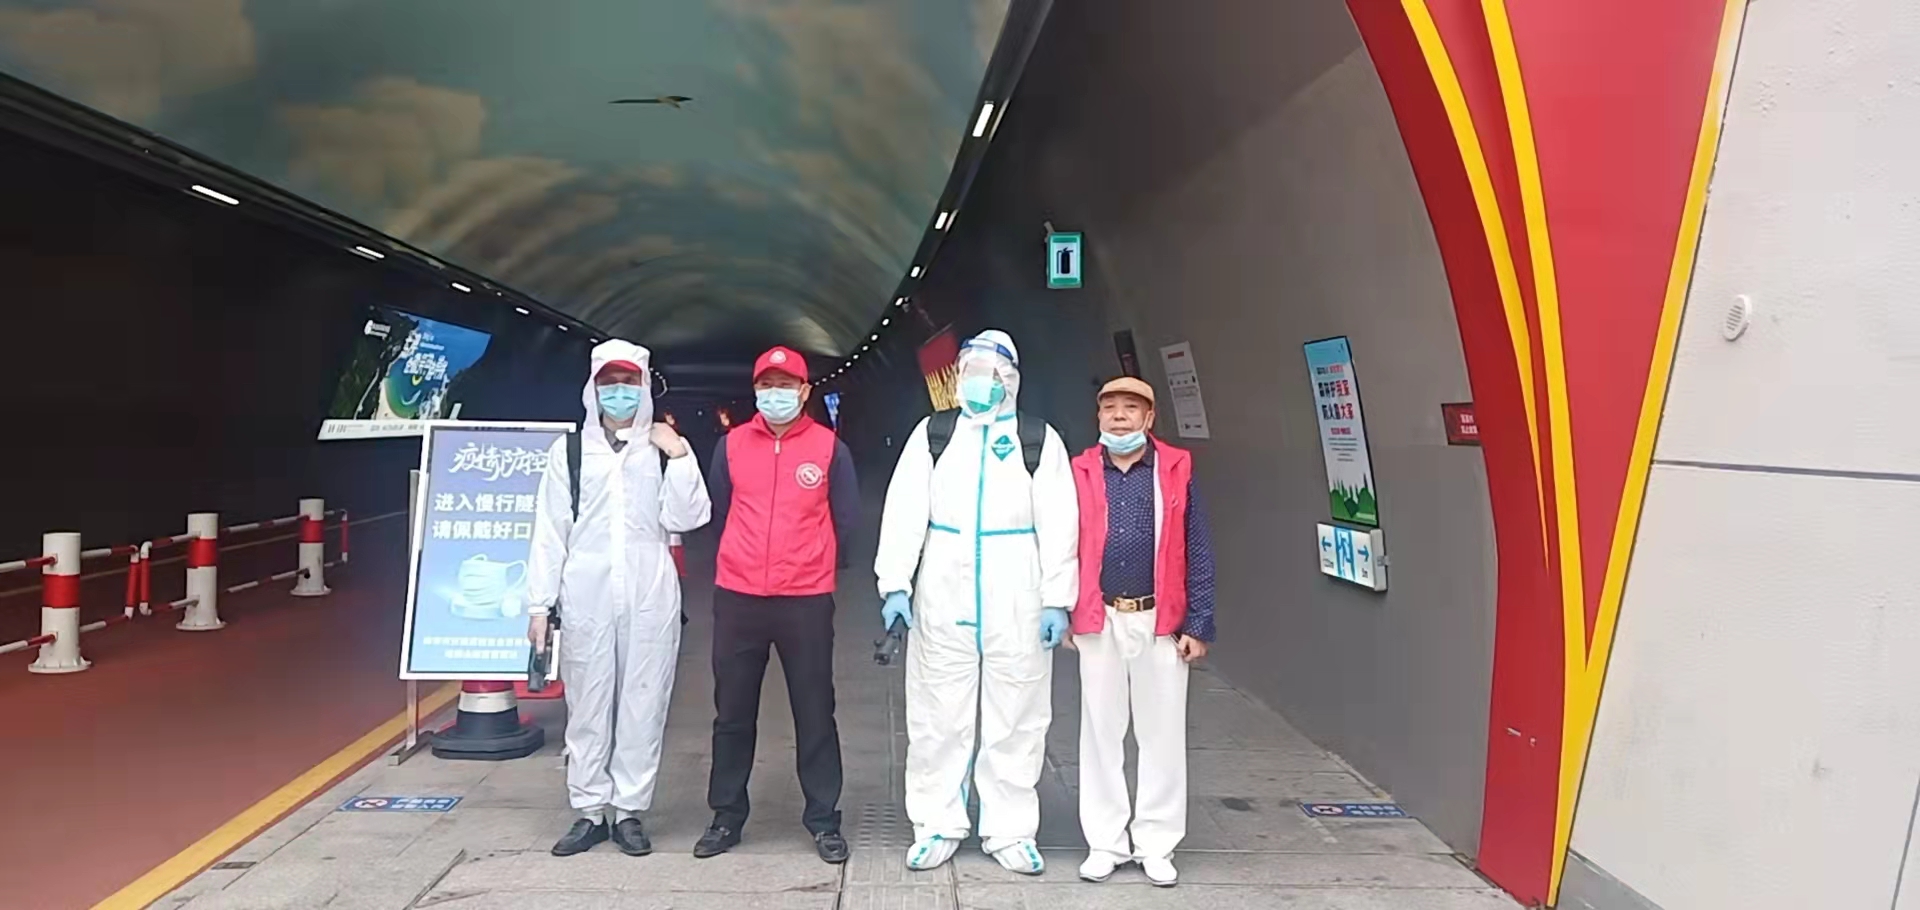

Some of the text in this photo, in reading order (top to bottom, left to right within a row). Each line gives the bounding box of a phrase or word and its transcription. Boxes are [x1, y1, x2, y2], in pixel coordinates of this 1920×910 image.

[448, 442, 550, 481] 疫情防控
[434, 493, 538, 512] 进入慢行隧
[432, 520, 532, 540] 请佩戴好口
